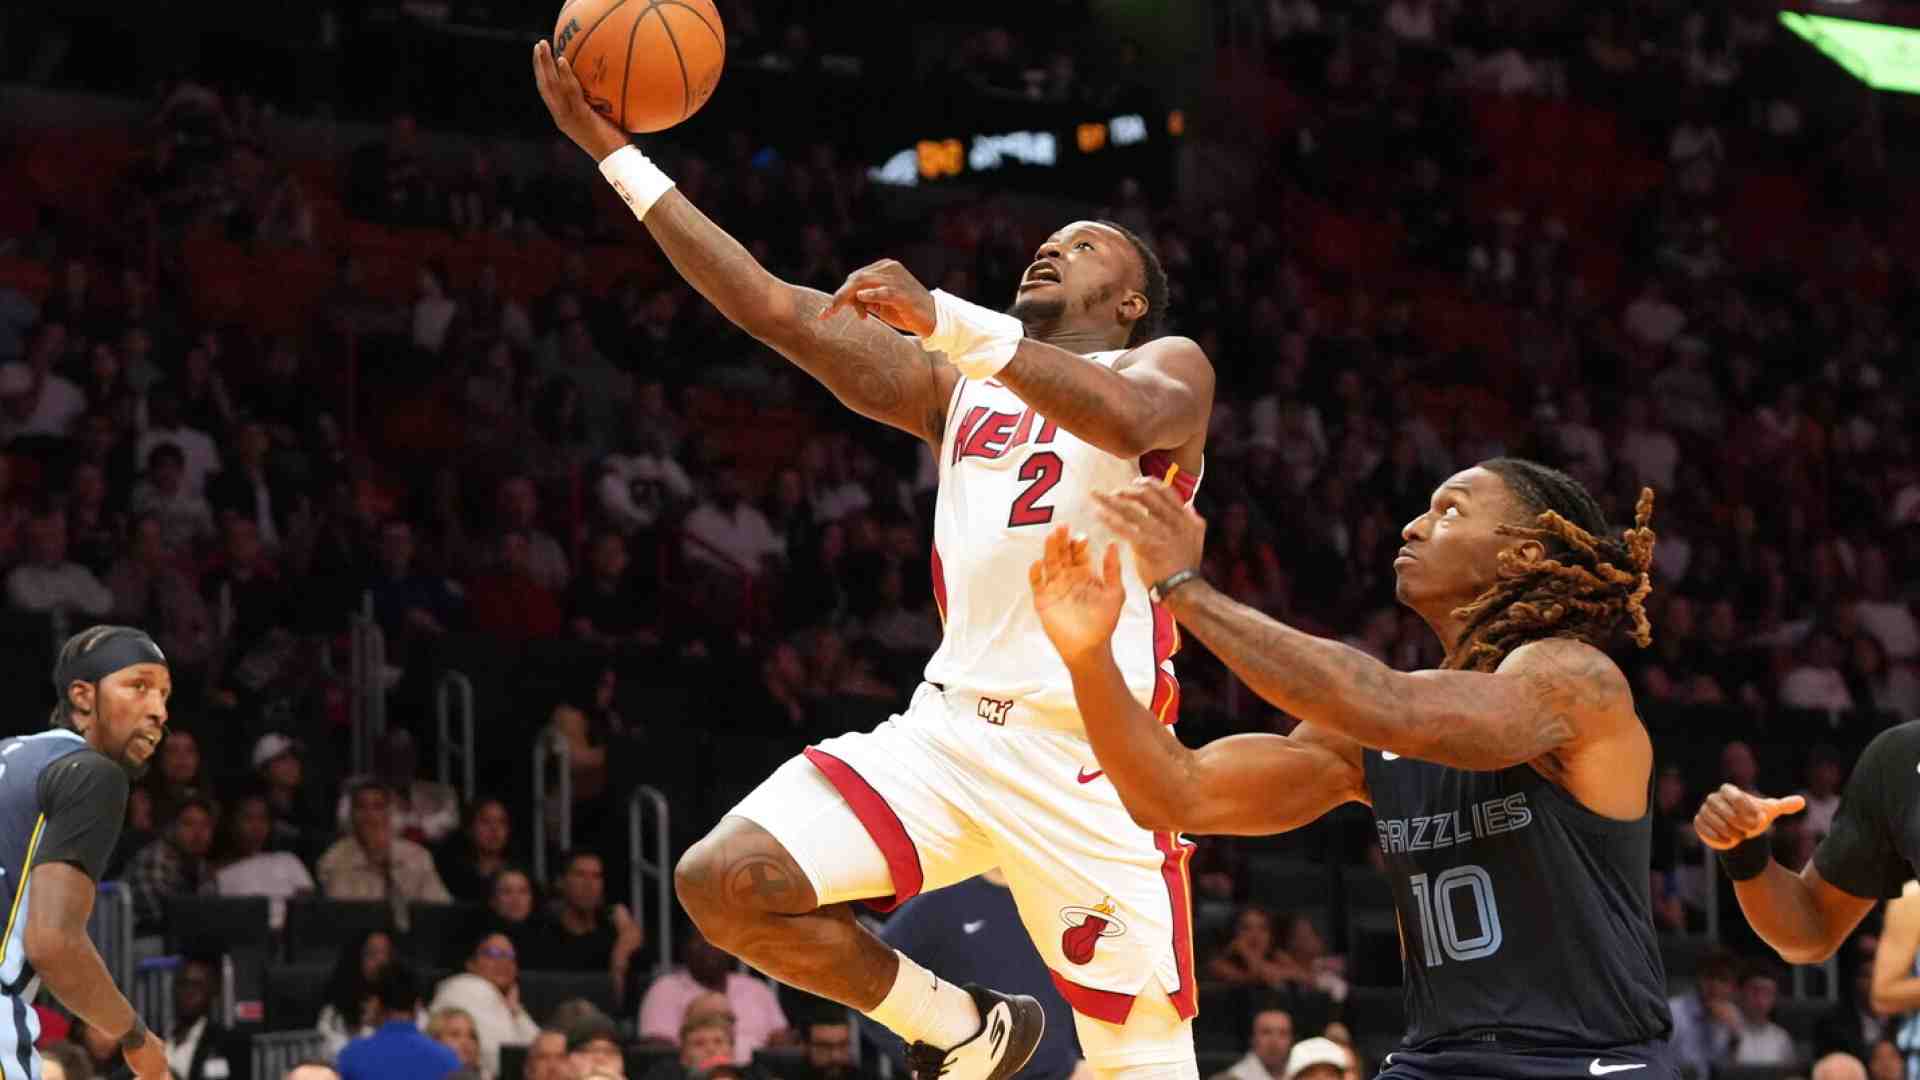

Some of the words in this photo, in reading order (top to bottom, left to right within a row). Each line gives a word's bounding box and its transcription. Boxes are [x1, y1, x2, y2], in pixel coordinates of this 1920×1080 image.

[1008, 450, 1063, 528] 2
[1376, 792, 1532, 854] GRIZZLIES
[1409, 864, 1502, 967] 10
